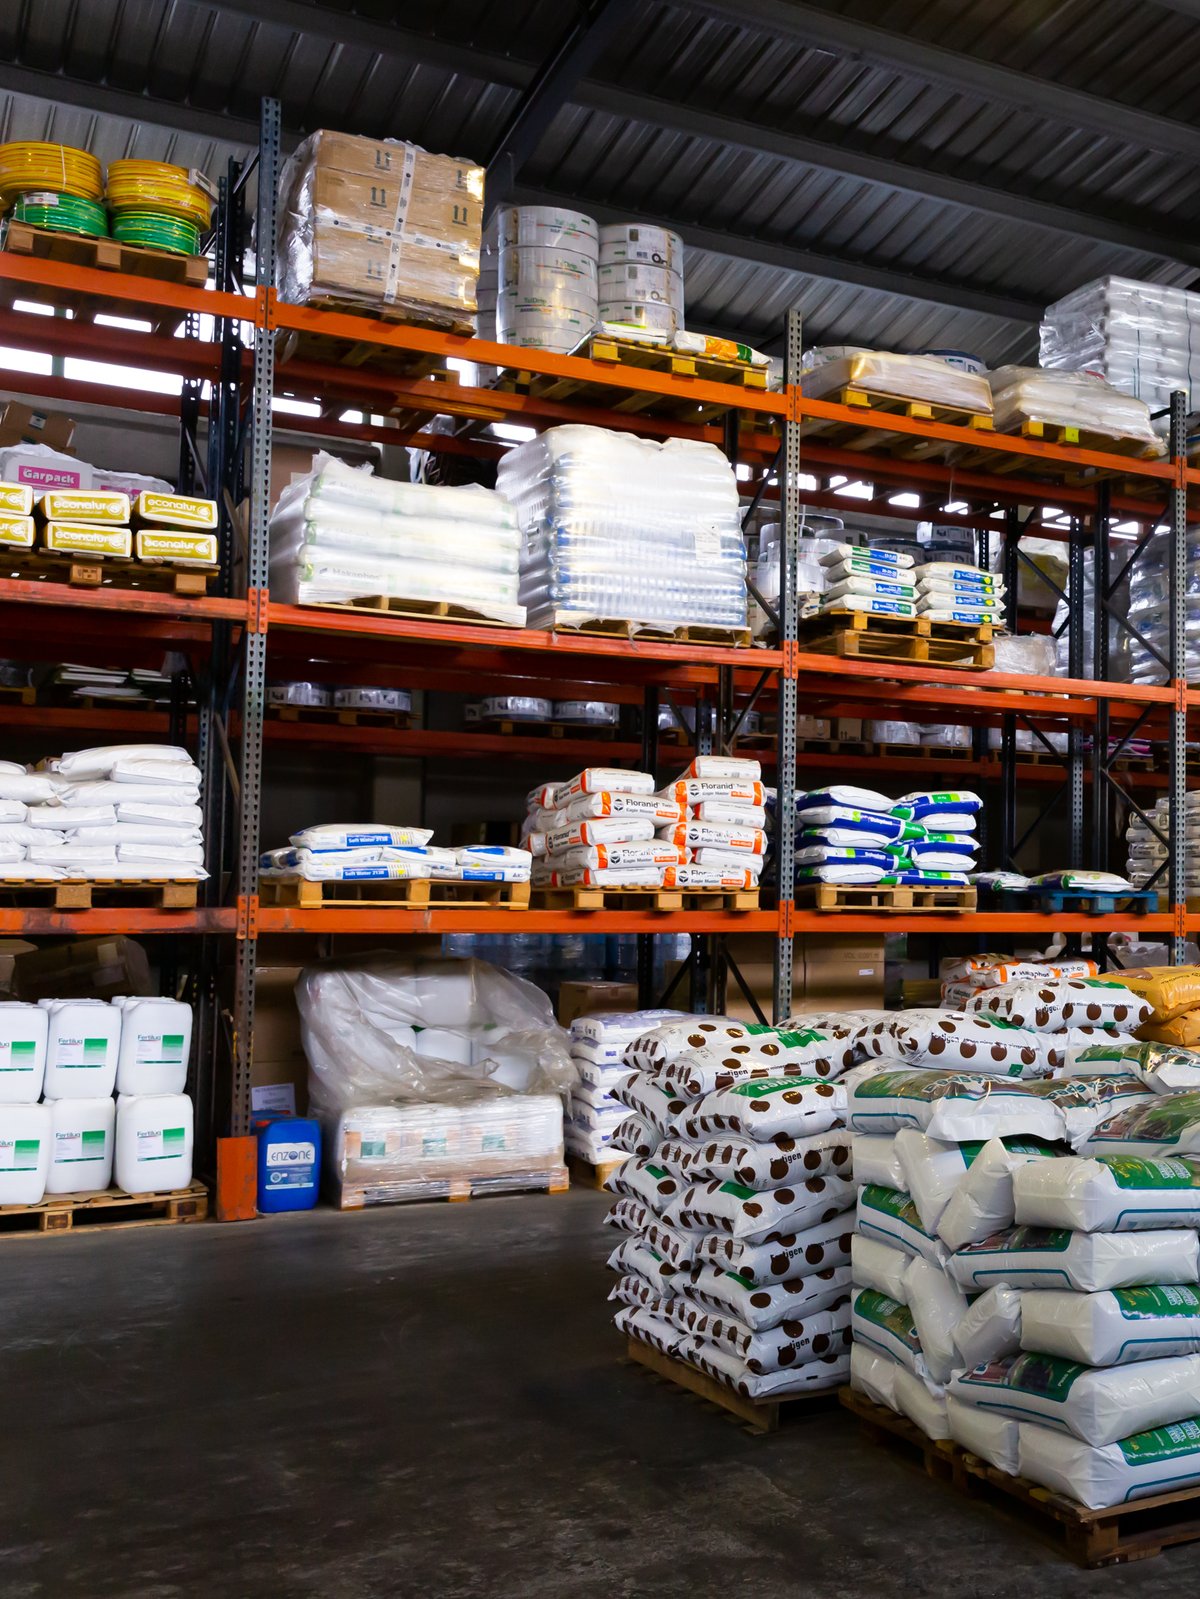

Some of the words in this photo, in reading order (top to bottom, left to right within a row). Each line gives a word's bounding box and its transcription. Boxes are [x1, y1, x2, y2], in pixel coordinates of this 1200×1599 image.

[23, 468, 75, 485] Garpack
[54, 501, 107, 511] econatur
[147, 498, 197, 512] econatur
[55, 530, 109, 543] econatur
[144, 537, 195, 550] econatur
[701, 782, 733, 791] Floranid
[626, 799, 660, 808] Floranid
